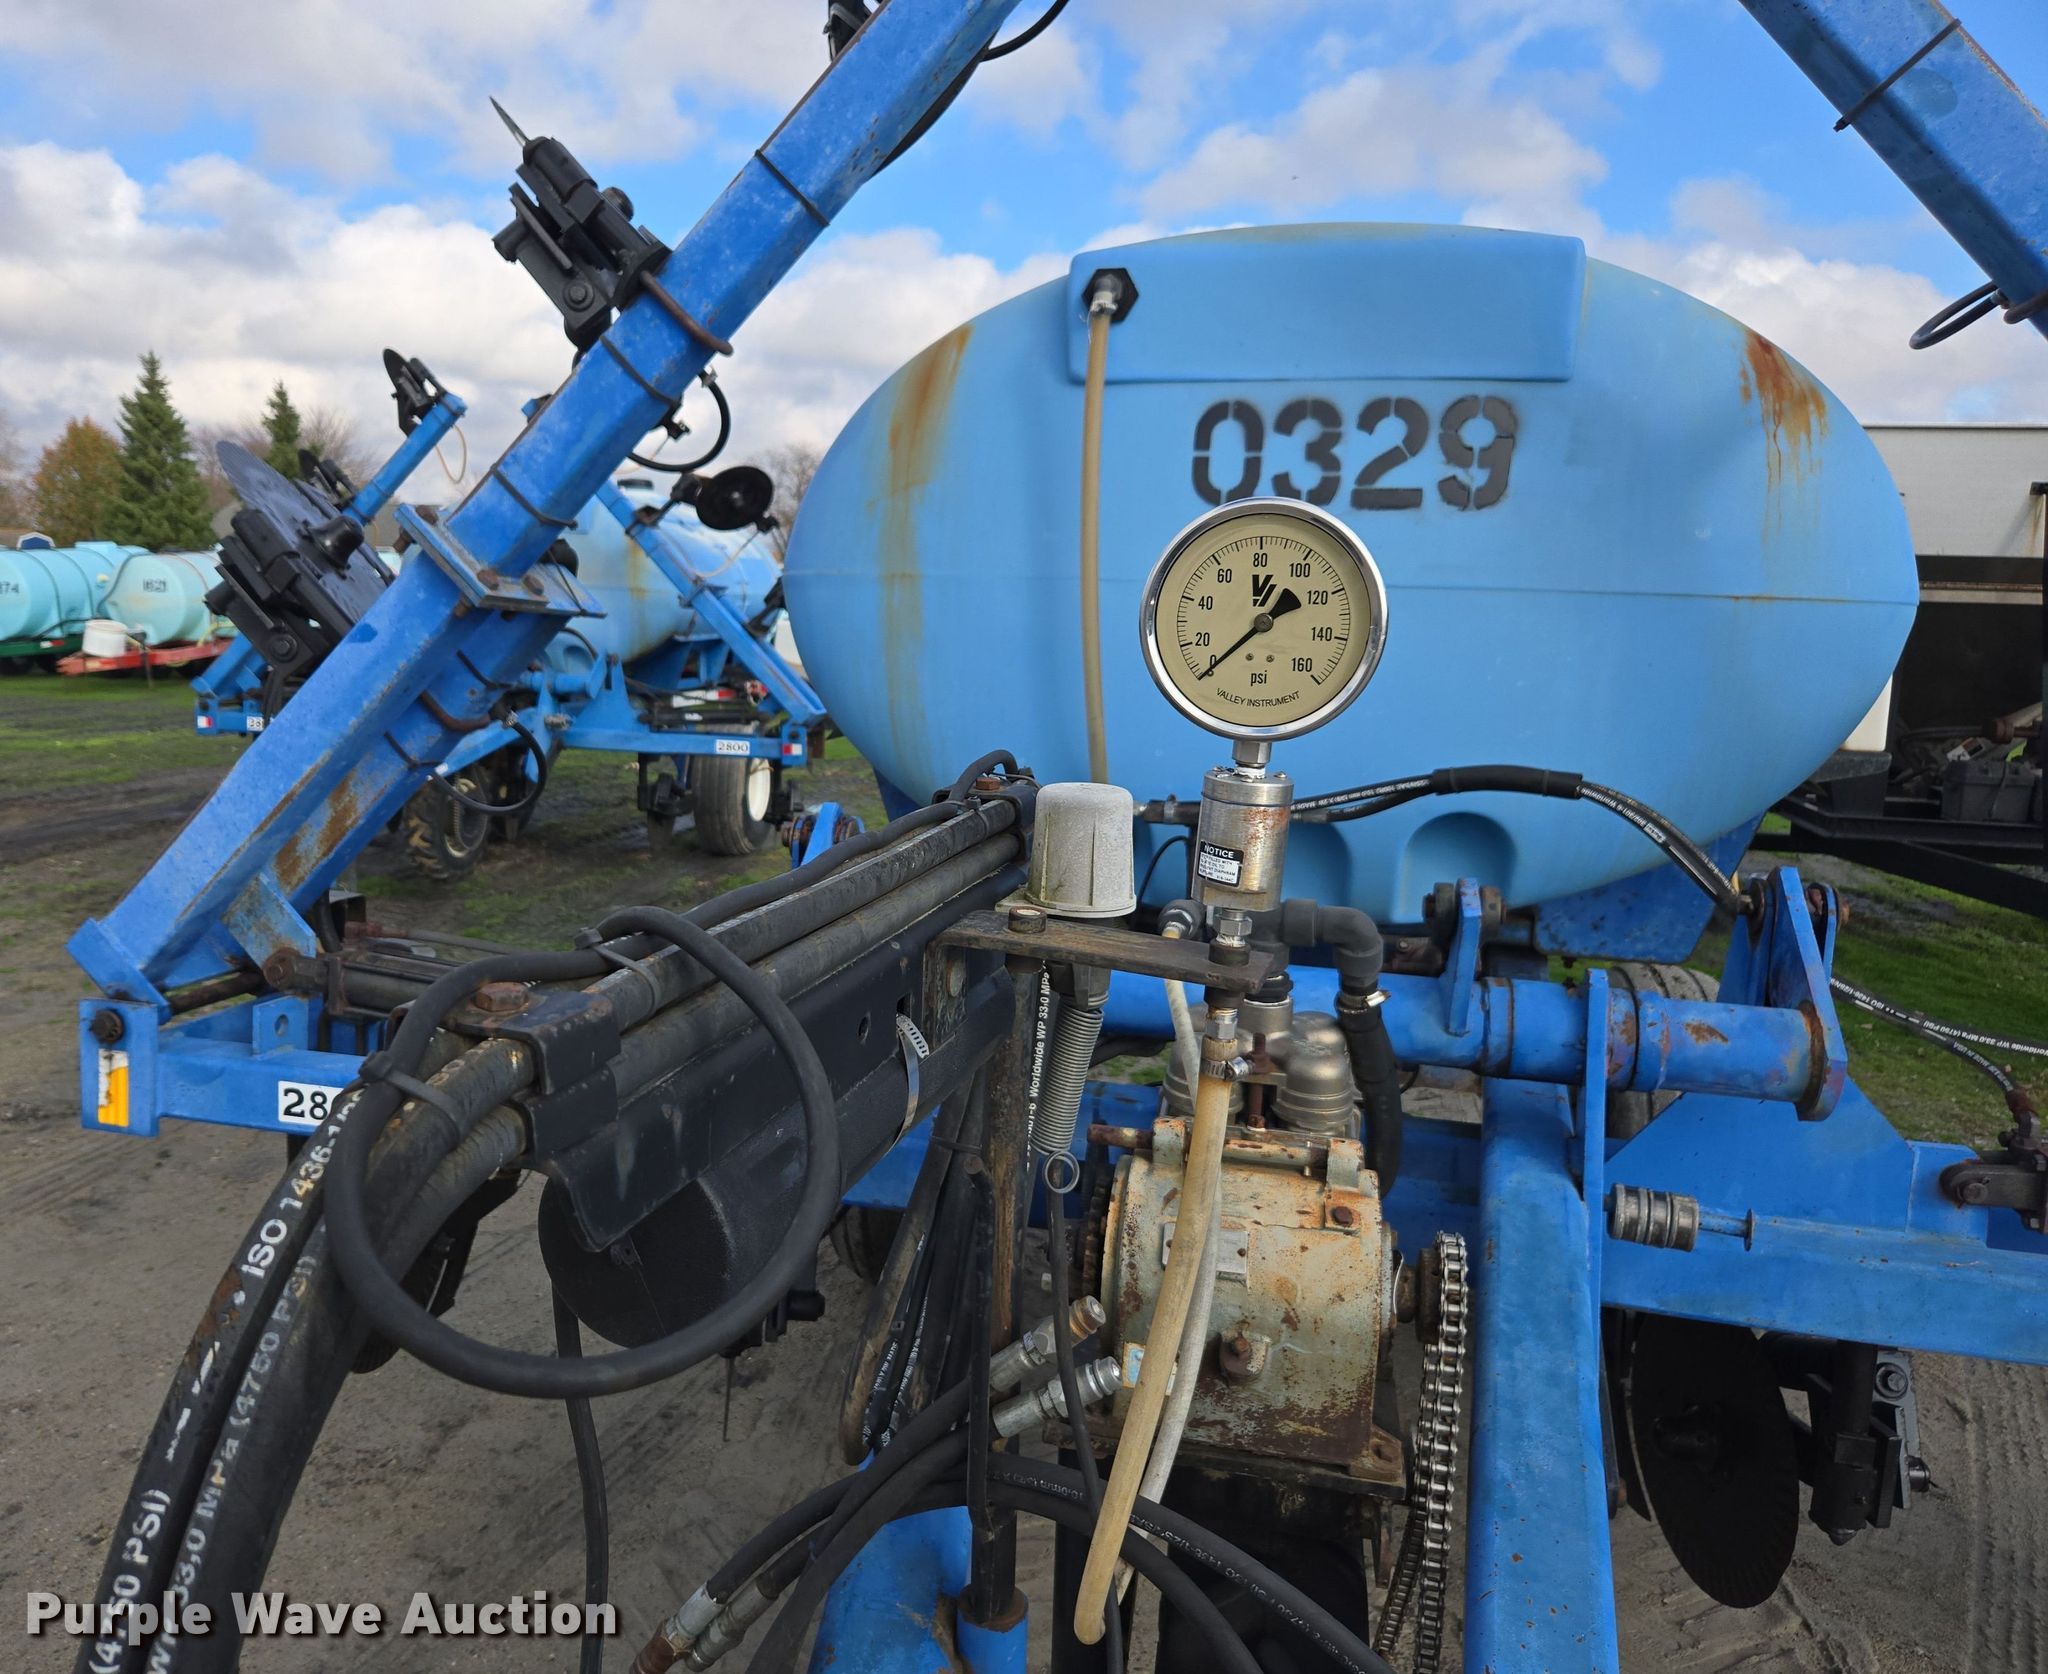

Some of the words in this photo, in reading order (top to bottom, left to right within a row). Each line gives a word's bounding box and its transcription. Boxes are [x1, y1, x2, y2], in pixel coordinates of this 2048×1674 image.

[1192, 395, 1518, 511] 0329
[1253, 552, 1268, 567] 80
[1217, 568, 1232, 584] 60
[1289, 562, 1311, 578] 100
[1198, 596, 1213, 610] 40
[1307, 590, 1328, 605] 120
[1195, 632, 1210, 647] 20
[1311, 627, 1333, 642] 140
[1209, 655, 1217, 670] 0
[1291, 657, 1313, 672] 160
[1250, 669, 1268, 687] psi
[1216, 687, 1246, 706] VALLEY
[1246, 690, 1301, 708] INSTRUMENT
[718, 742, 749, 753] 2800
[1204, 844, 1235, 859] NOTICE
[1039, 995, 1049, 1019] 33,0
[1036, 1023, 1046, 1041] WP
[1996, 1039, 2011, 1049] WP
[1029, 1041, 1045, 1098] Worldwide
[229, 1330, 281, 1427] (4750
[122, 1489, 171, 1566] PSI)
[240, 1218, 288, 1279] ISO
